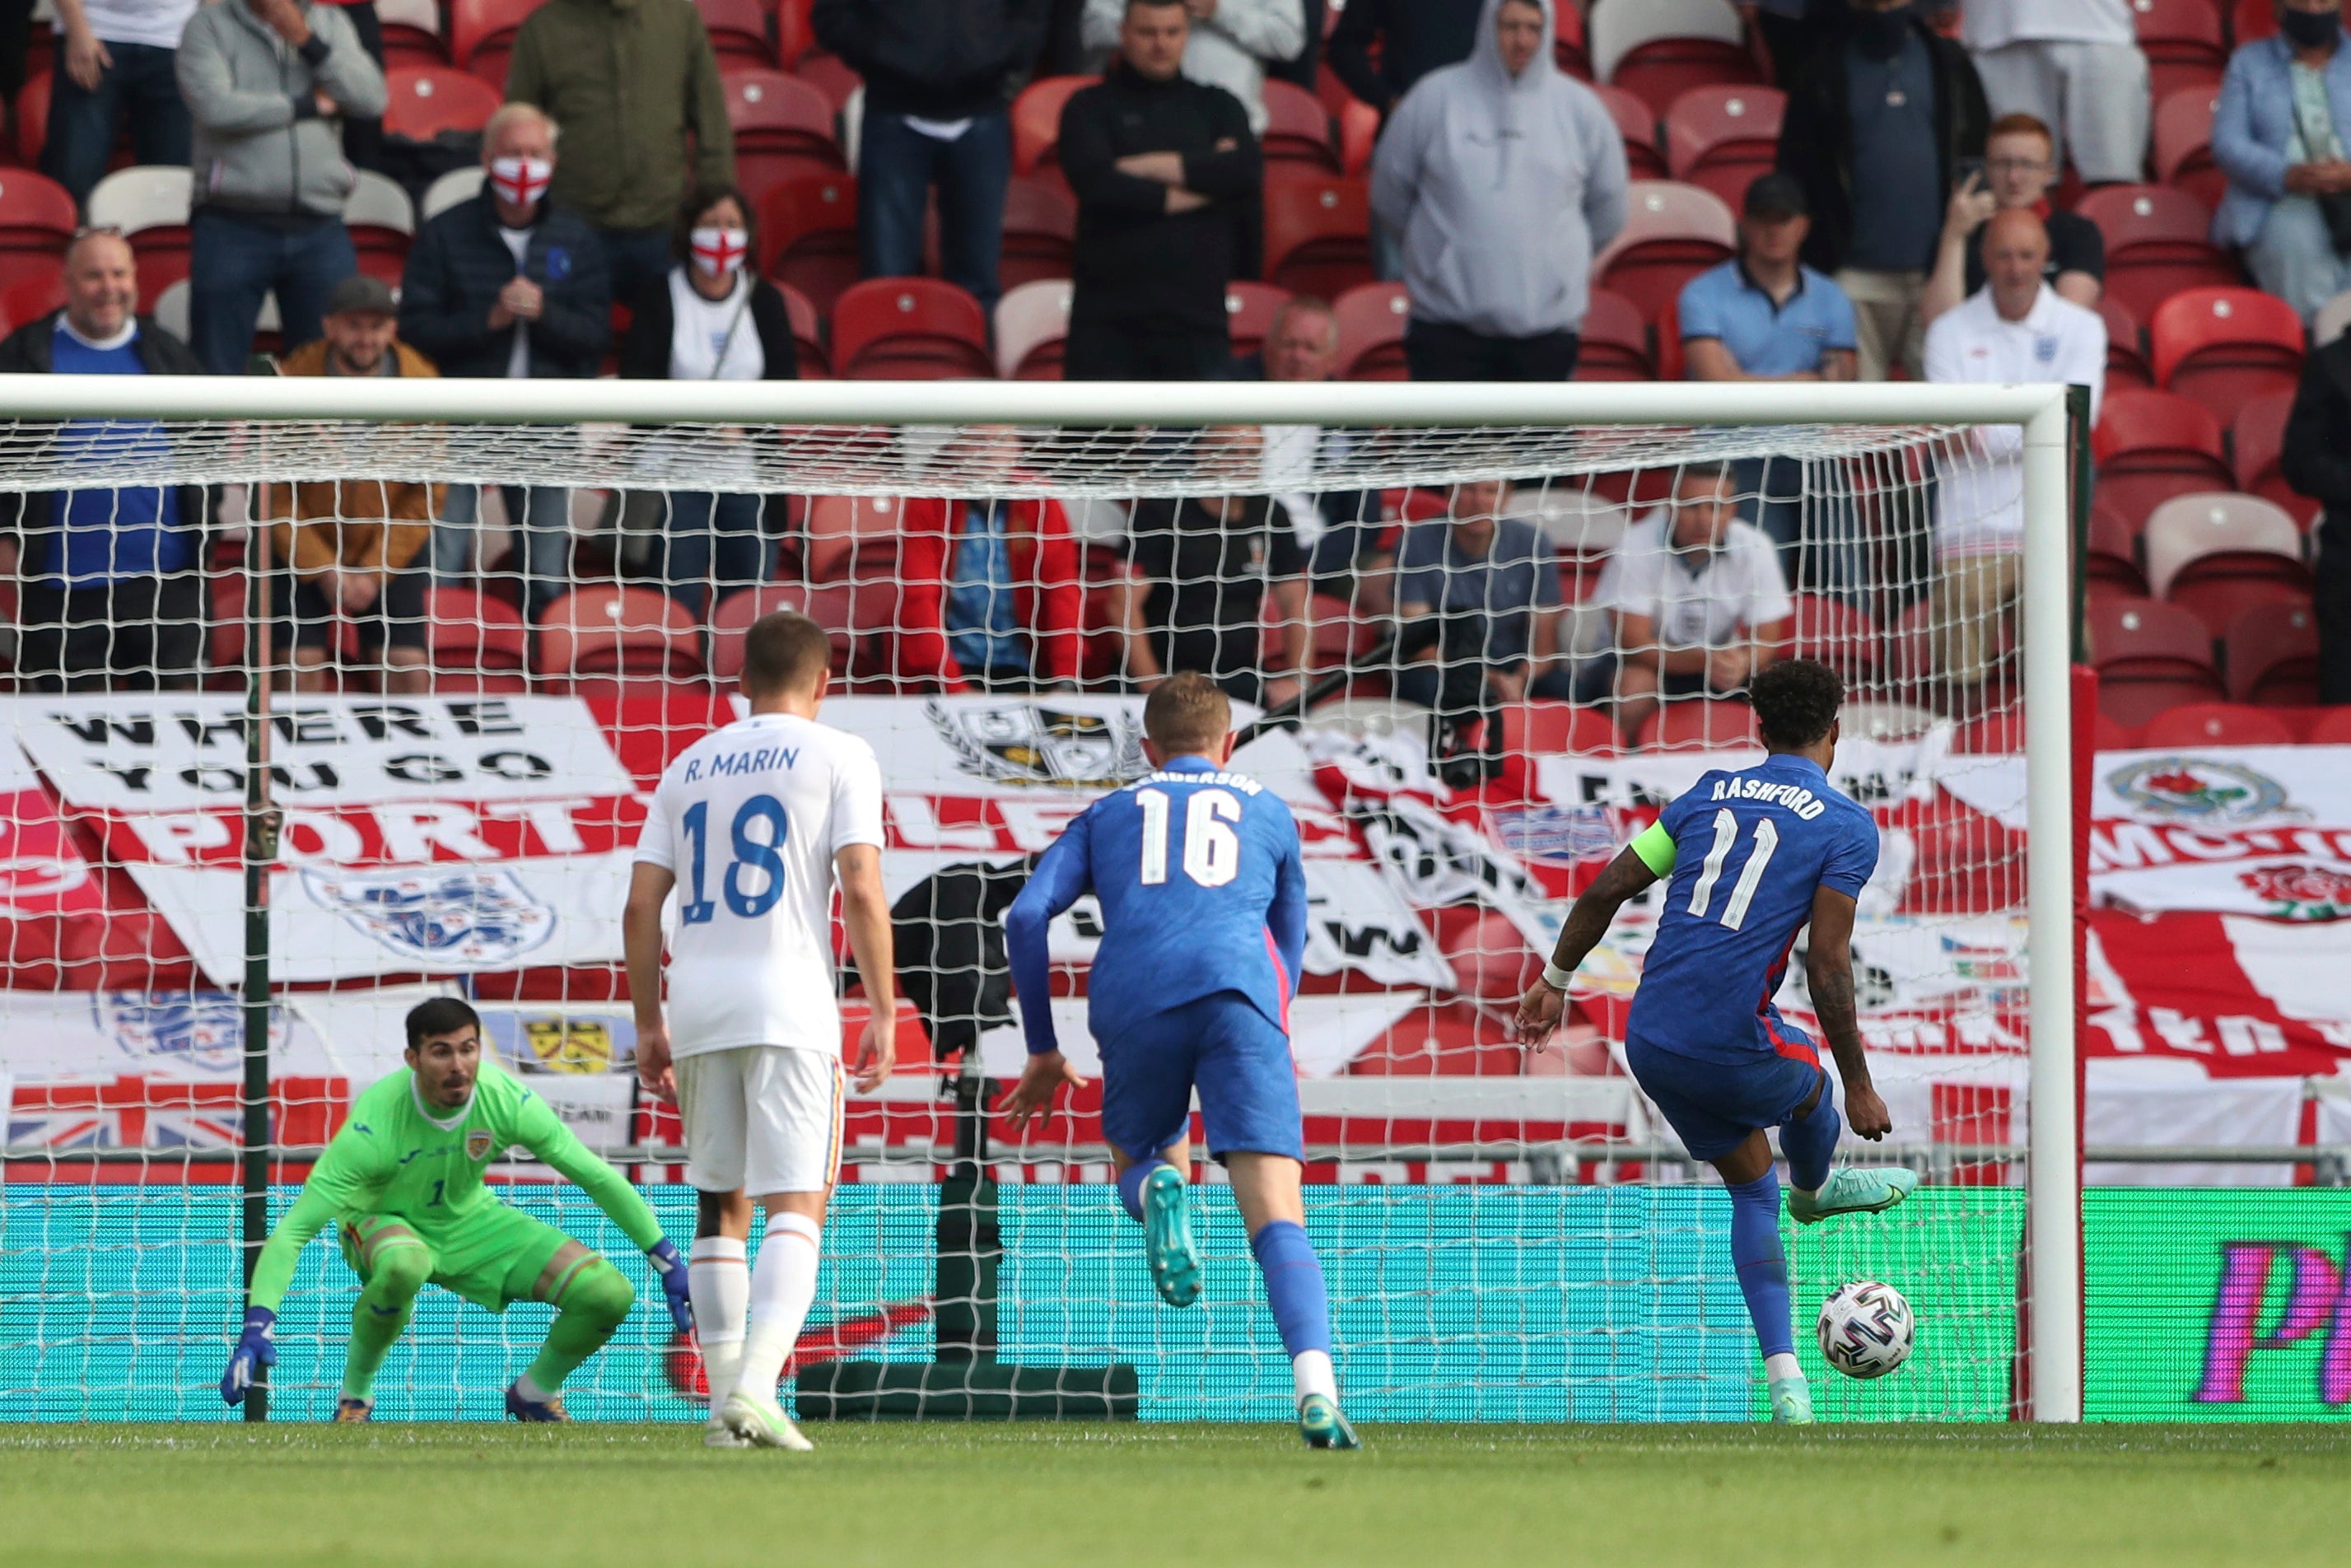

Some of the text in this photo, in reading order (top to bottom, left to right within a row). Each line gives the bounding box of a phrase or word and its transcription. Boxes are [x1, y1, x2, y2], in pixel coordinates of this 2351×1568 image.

[52, 701, 525, 745] WHERE
[91, 751, 555, 791] YOU GO
[684, 748, 800, 784] R. MARIN
[1710, 777, 1826, 821] RASHFORD
[125, 796, 598, 865] PORT
[1136, 787, 1243, 889] 16
[683, 795, 787, 926] 18
[1686, 806, 1780, 931] 11
[426, 1179, 445, 1208] 1
